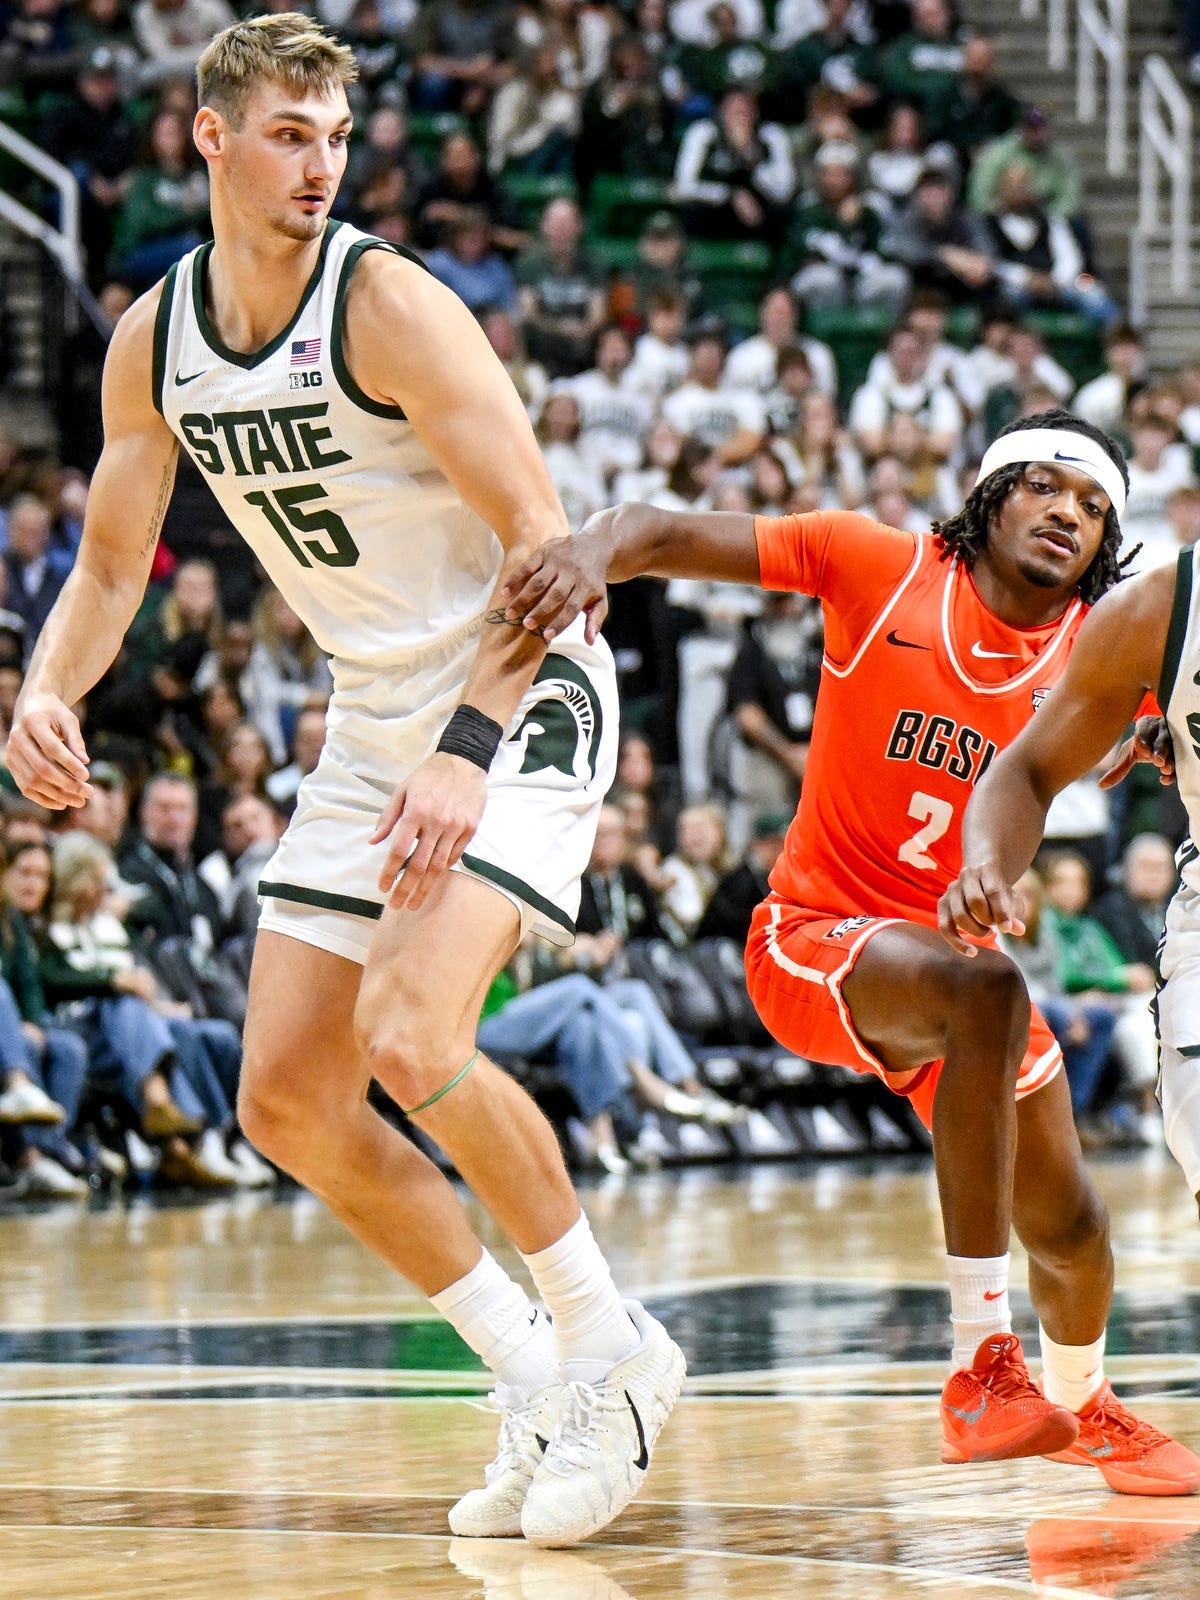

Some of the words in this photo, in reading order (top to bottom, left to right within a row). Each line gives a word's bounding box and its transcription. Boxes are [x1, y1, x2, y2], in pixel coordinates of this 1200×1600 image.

[179, 401, 353, 476] STATE
[243, 482, 360, 568] 15
[897, 790, 954, 871] 2
